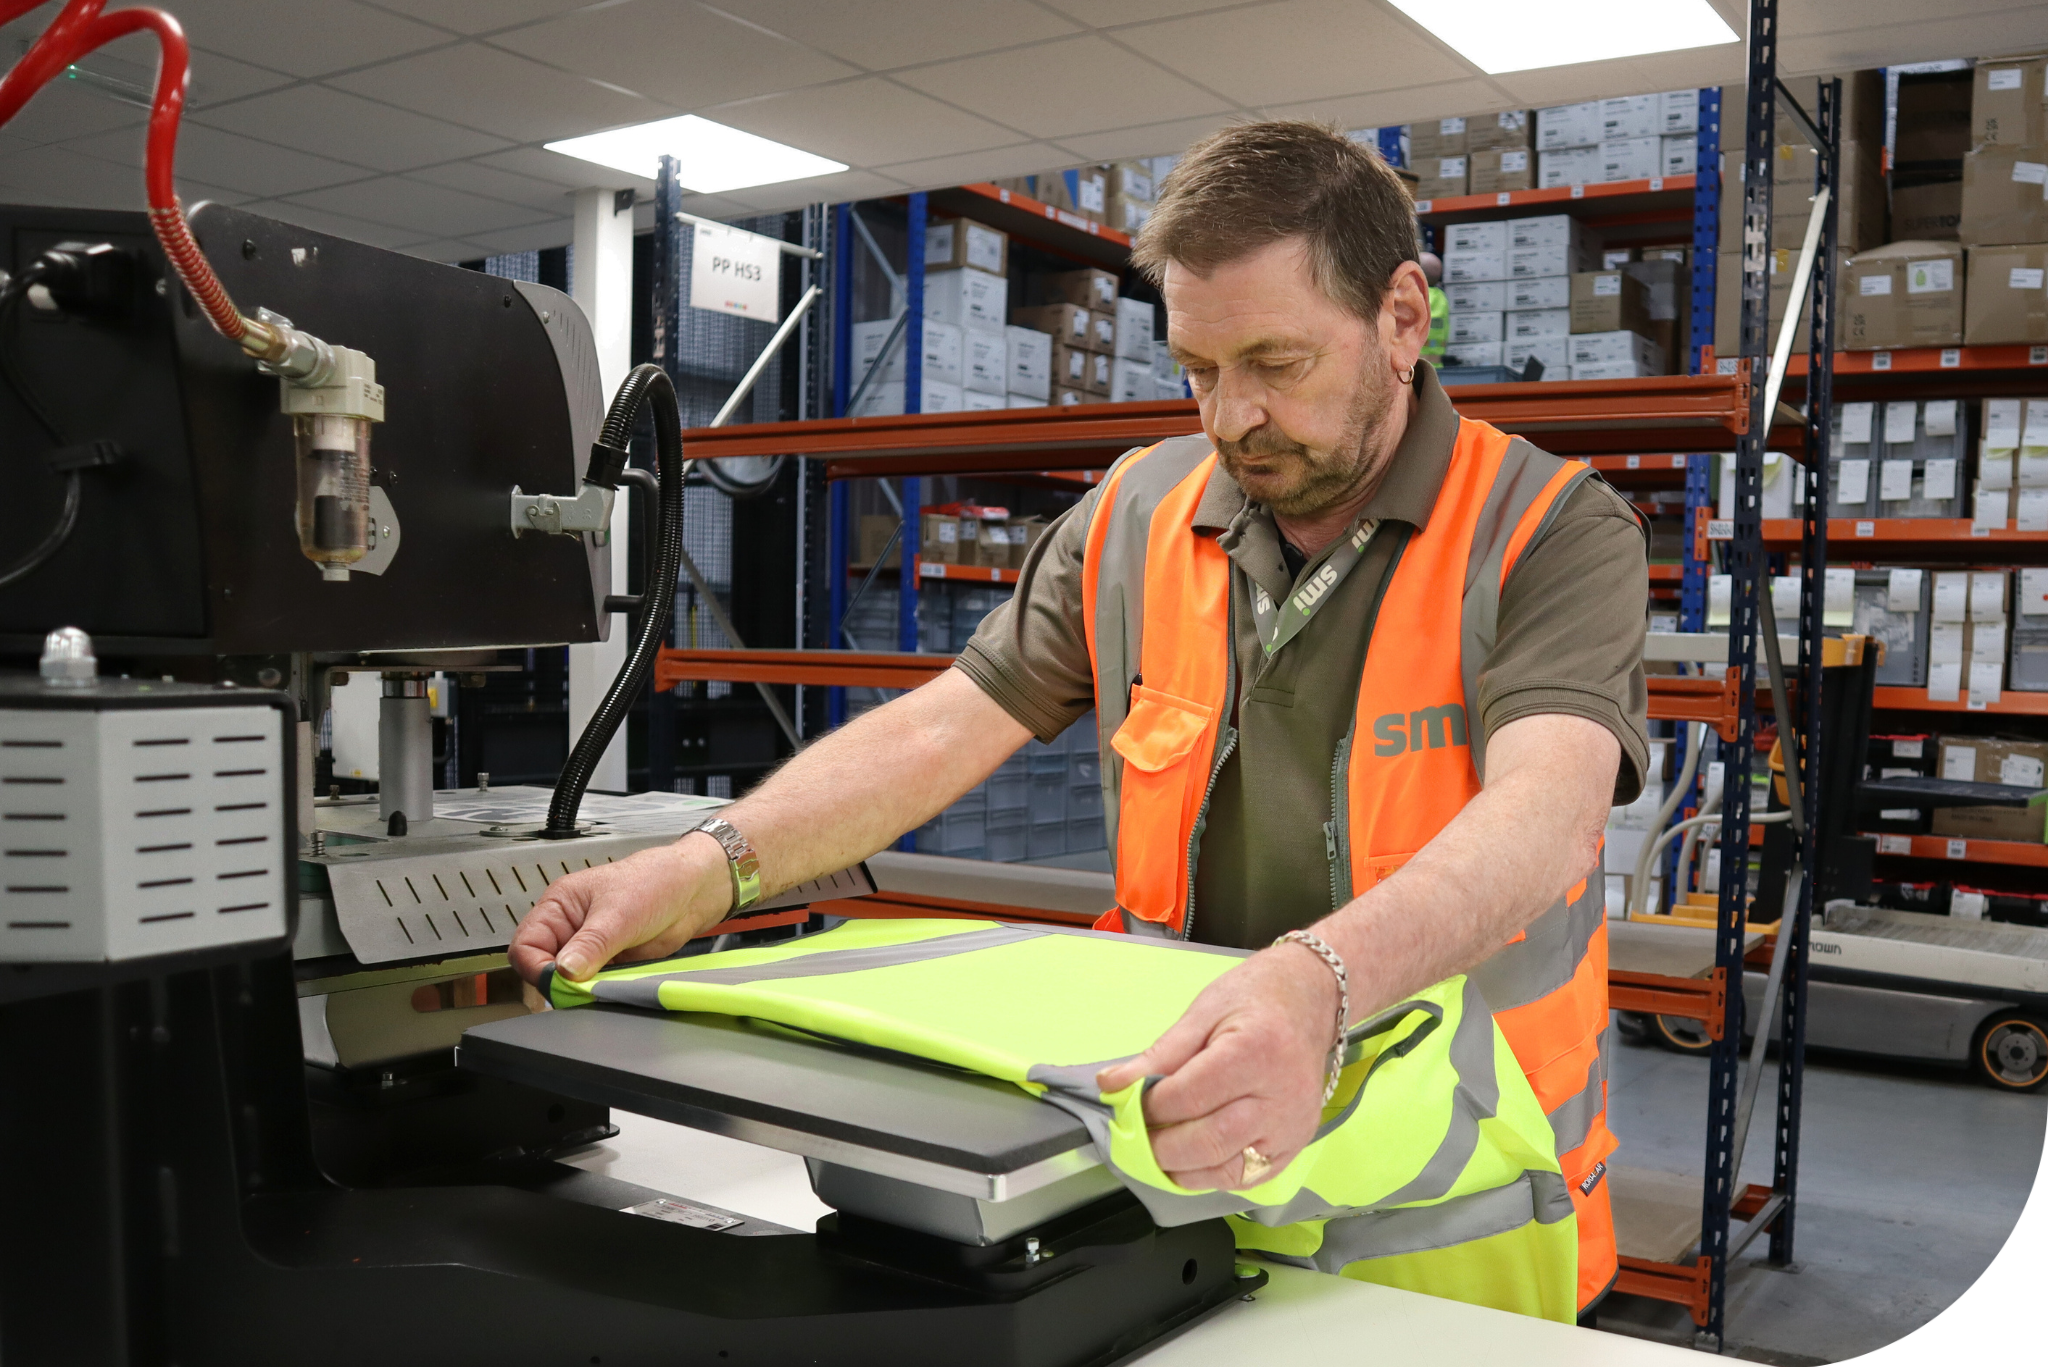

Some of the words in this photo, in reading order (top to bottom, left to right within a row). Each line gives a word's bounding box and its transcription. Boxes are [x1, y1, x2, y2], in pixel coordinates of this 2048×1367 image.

[712, 256, 731, 274] PP
[734, 261, 762, 281] HS3
[1293, 564, 1338, 616] smi
